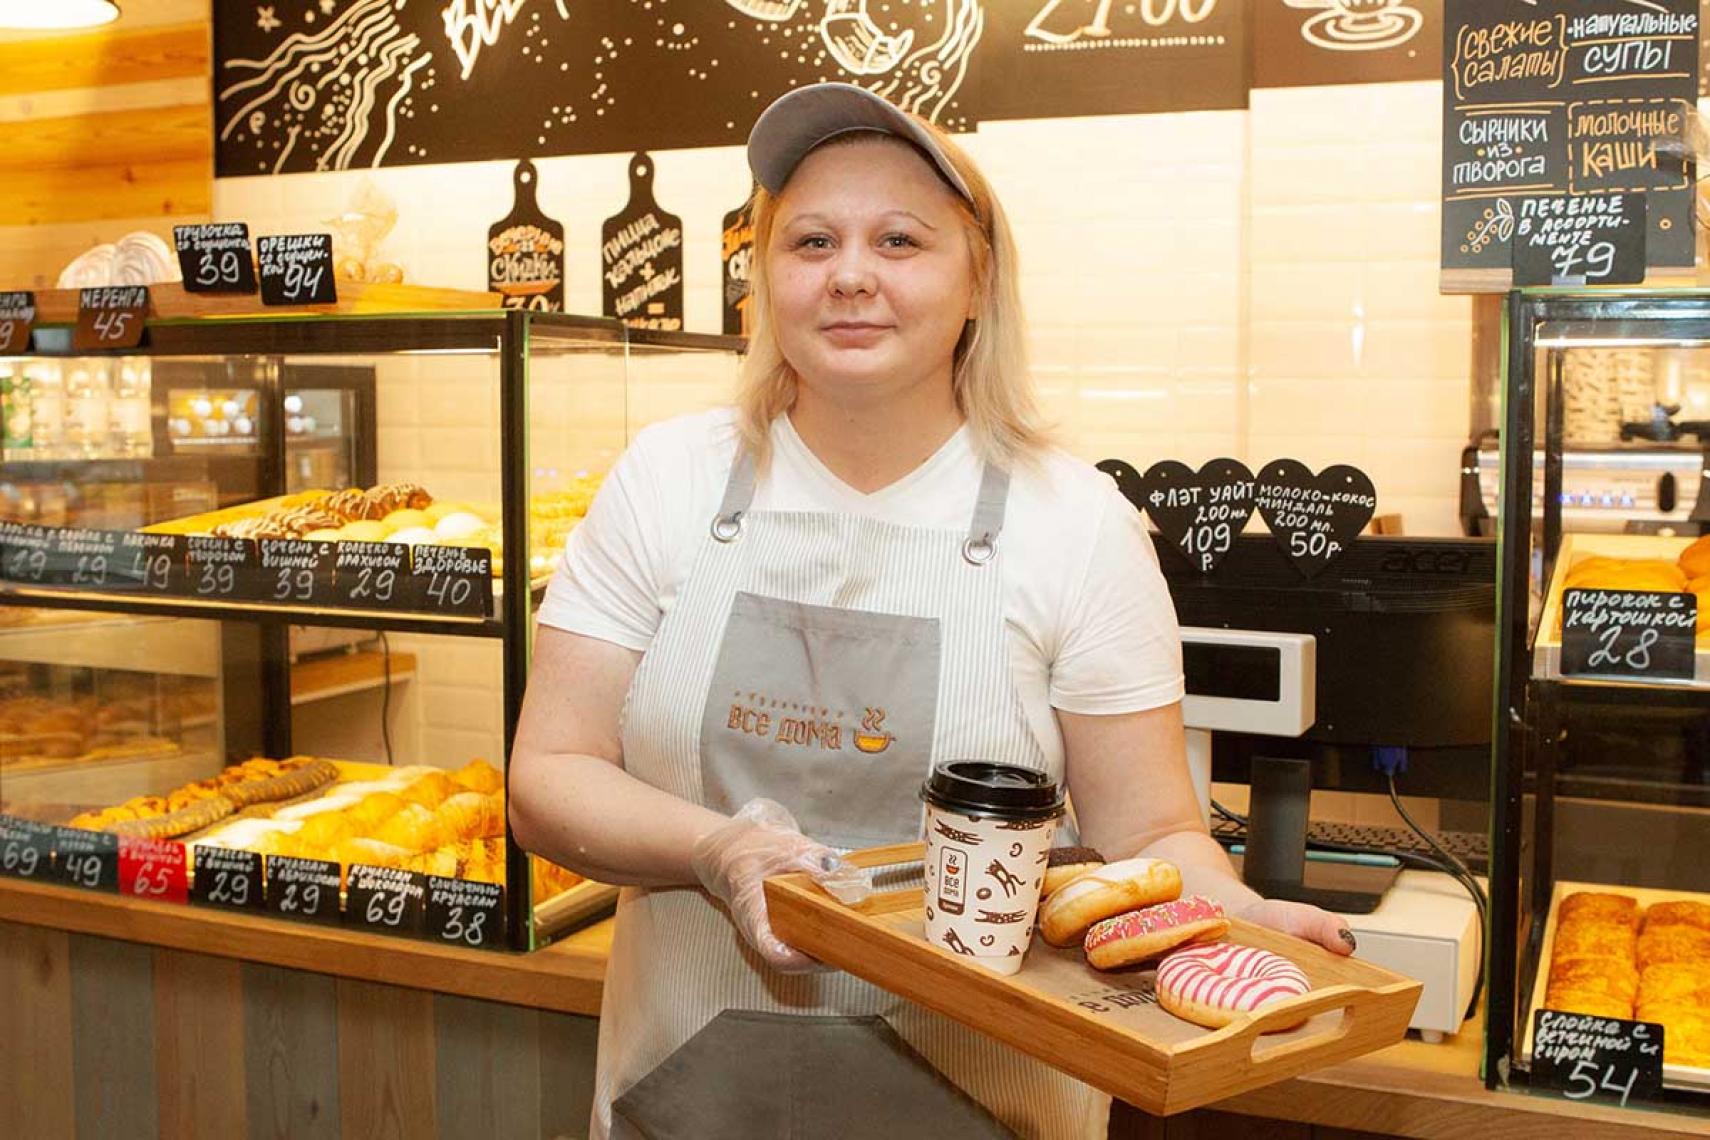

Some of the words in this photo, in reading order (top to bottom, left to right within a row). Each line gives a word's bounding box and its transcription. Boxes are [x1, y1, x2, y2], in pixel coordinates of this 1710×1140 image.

[1521, 195, 1624, 218] ПЕЧЕНЬЕ
[1518, 218, 1532, 235] В
[1529, 230, 1593, 247] МЕНТЕ
[196, 251, 239, 286] 39
[1551, 241, 1616, 278] 79
[283, 264, 325, 298] 94
[81, 287, 146, 309] МЕРЕНГА
[93, 311, 134, 341] 45
[1150, 487, 1202, 507] ФЛЭТ
[1210, 482, 1255, 504] УАЙТ
[1180, 523, 1231, 554] 109
[197, 563, 235, 594] 39
[273, 567, 314, 599] 39
[350, 567, 396, 600] 29
[427, 572, 471, 606] 40
[1588, 625, 1659, 669] 28
[3, 841, 39, 876] 69
[66, 853, 103, 887] 49
[133, 861, 175, 895] 65
[208, 871, 249, 904] 29
[280, 884, 320, 914] 29
[366, 891, 406, 926] 69
[442, 907, 487, 946] 38
[1563, 1060, 1640, 1107] 54
